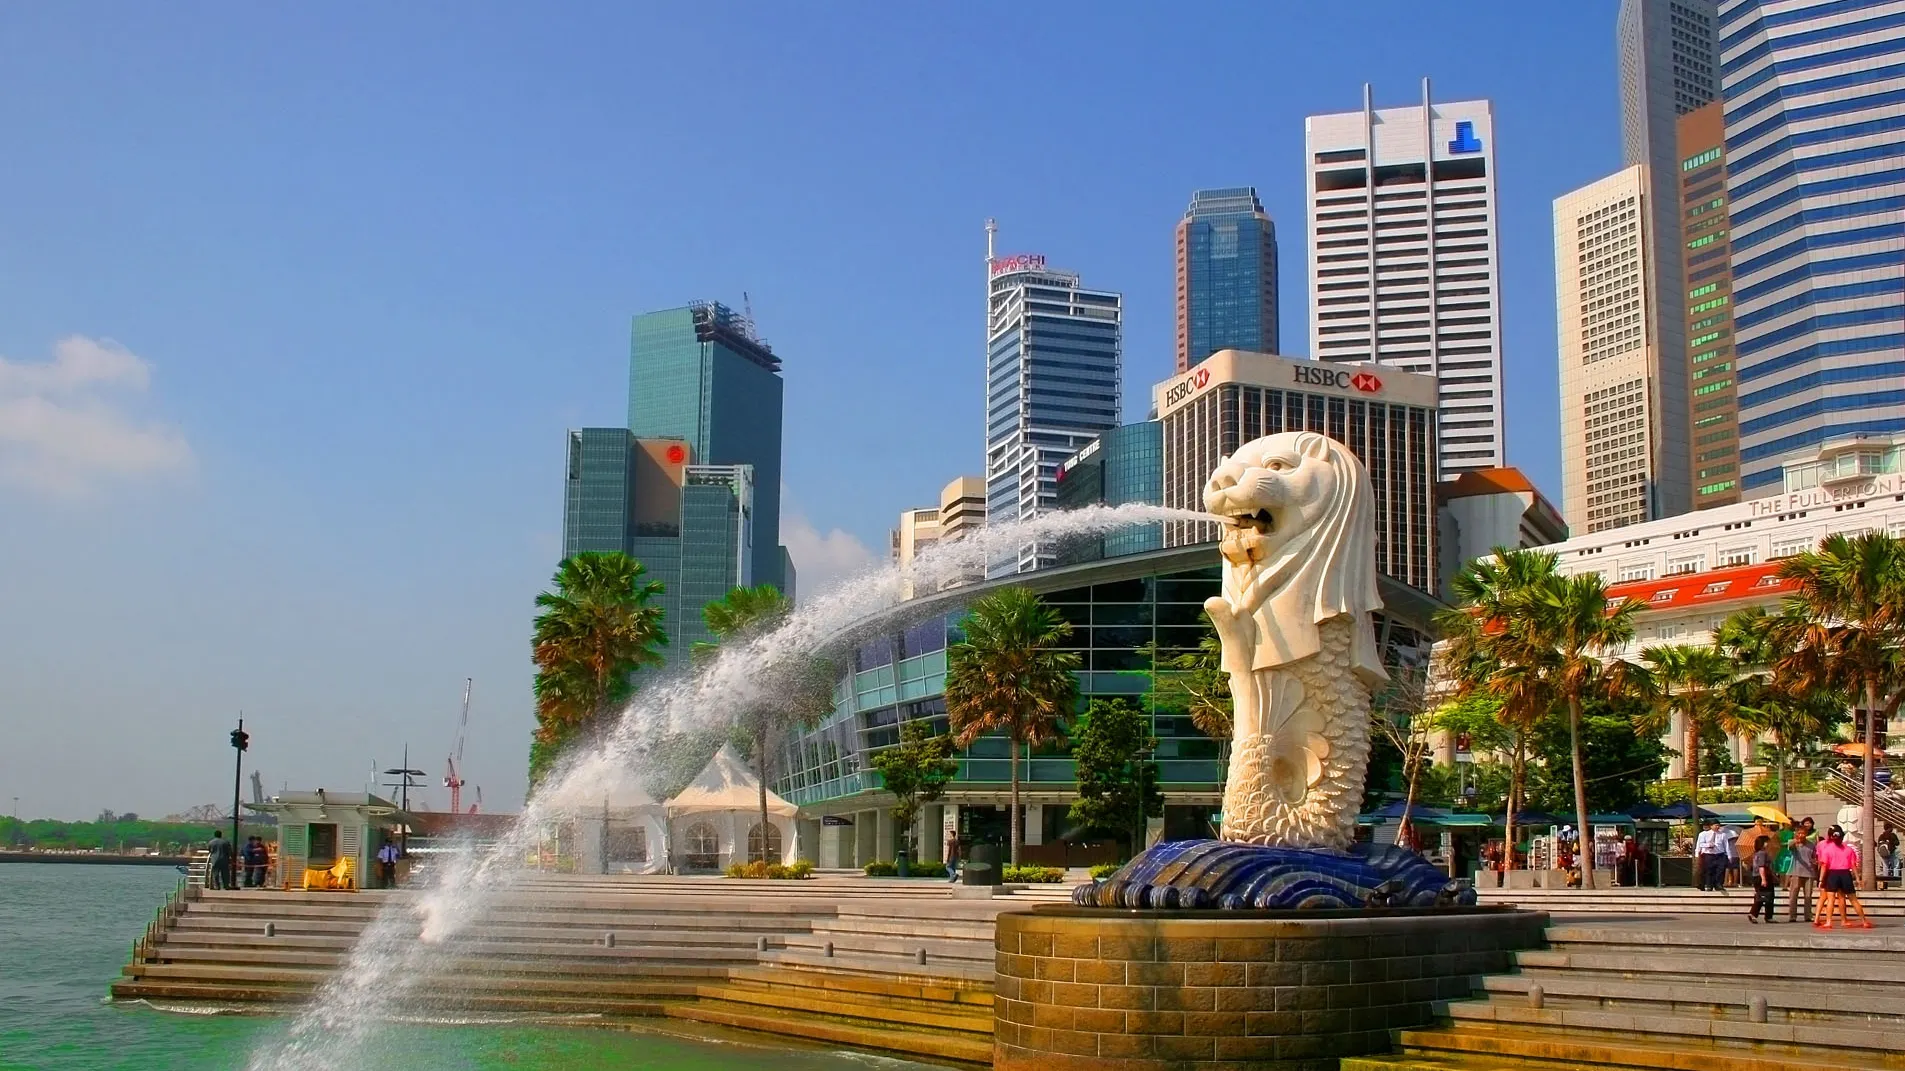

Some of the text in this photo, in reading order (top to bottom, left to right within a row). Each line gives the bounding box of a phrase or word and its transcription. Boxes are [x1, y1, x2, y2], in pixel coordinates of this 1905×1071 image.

[1166, 376, 1194, 408] HSBC
[1293, 364, 1350, 389] HSBC
[1748, 499, 1782, 516] THE
[1788, 480, 1892, 510] FULLERTON
